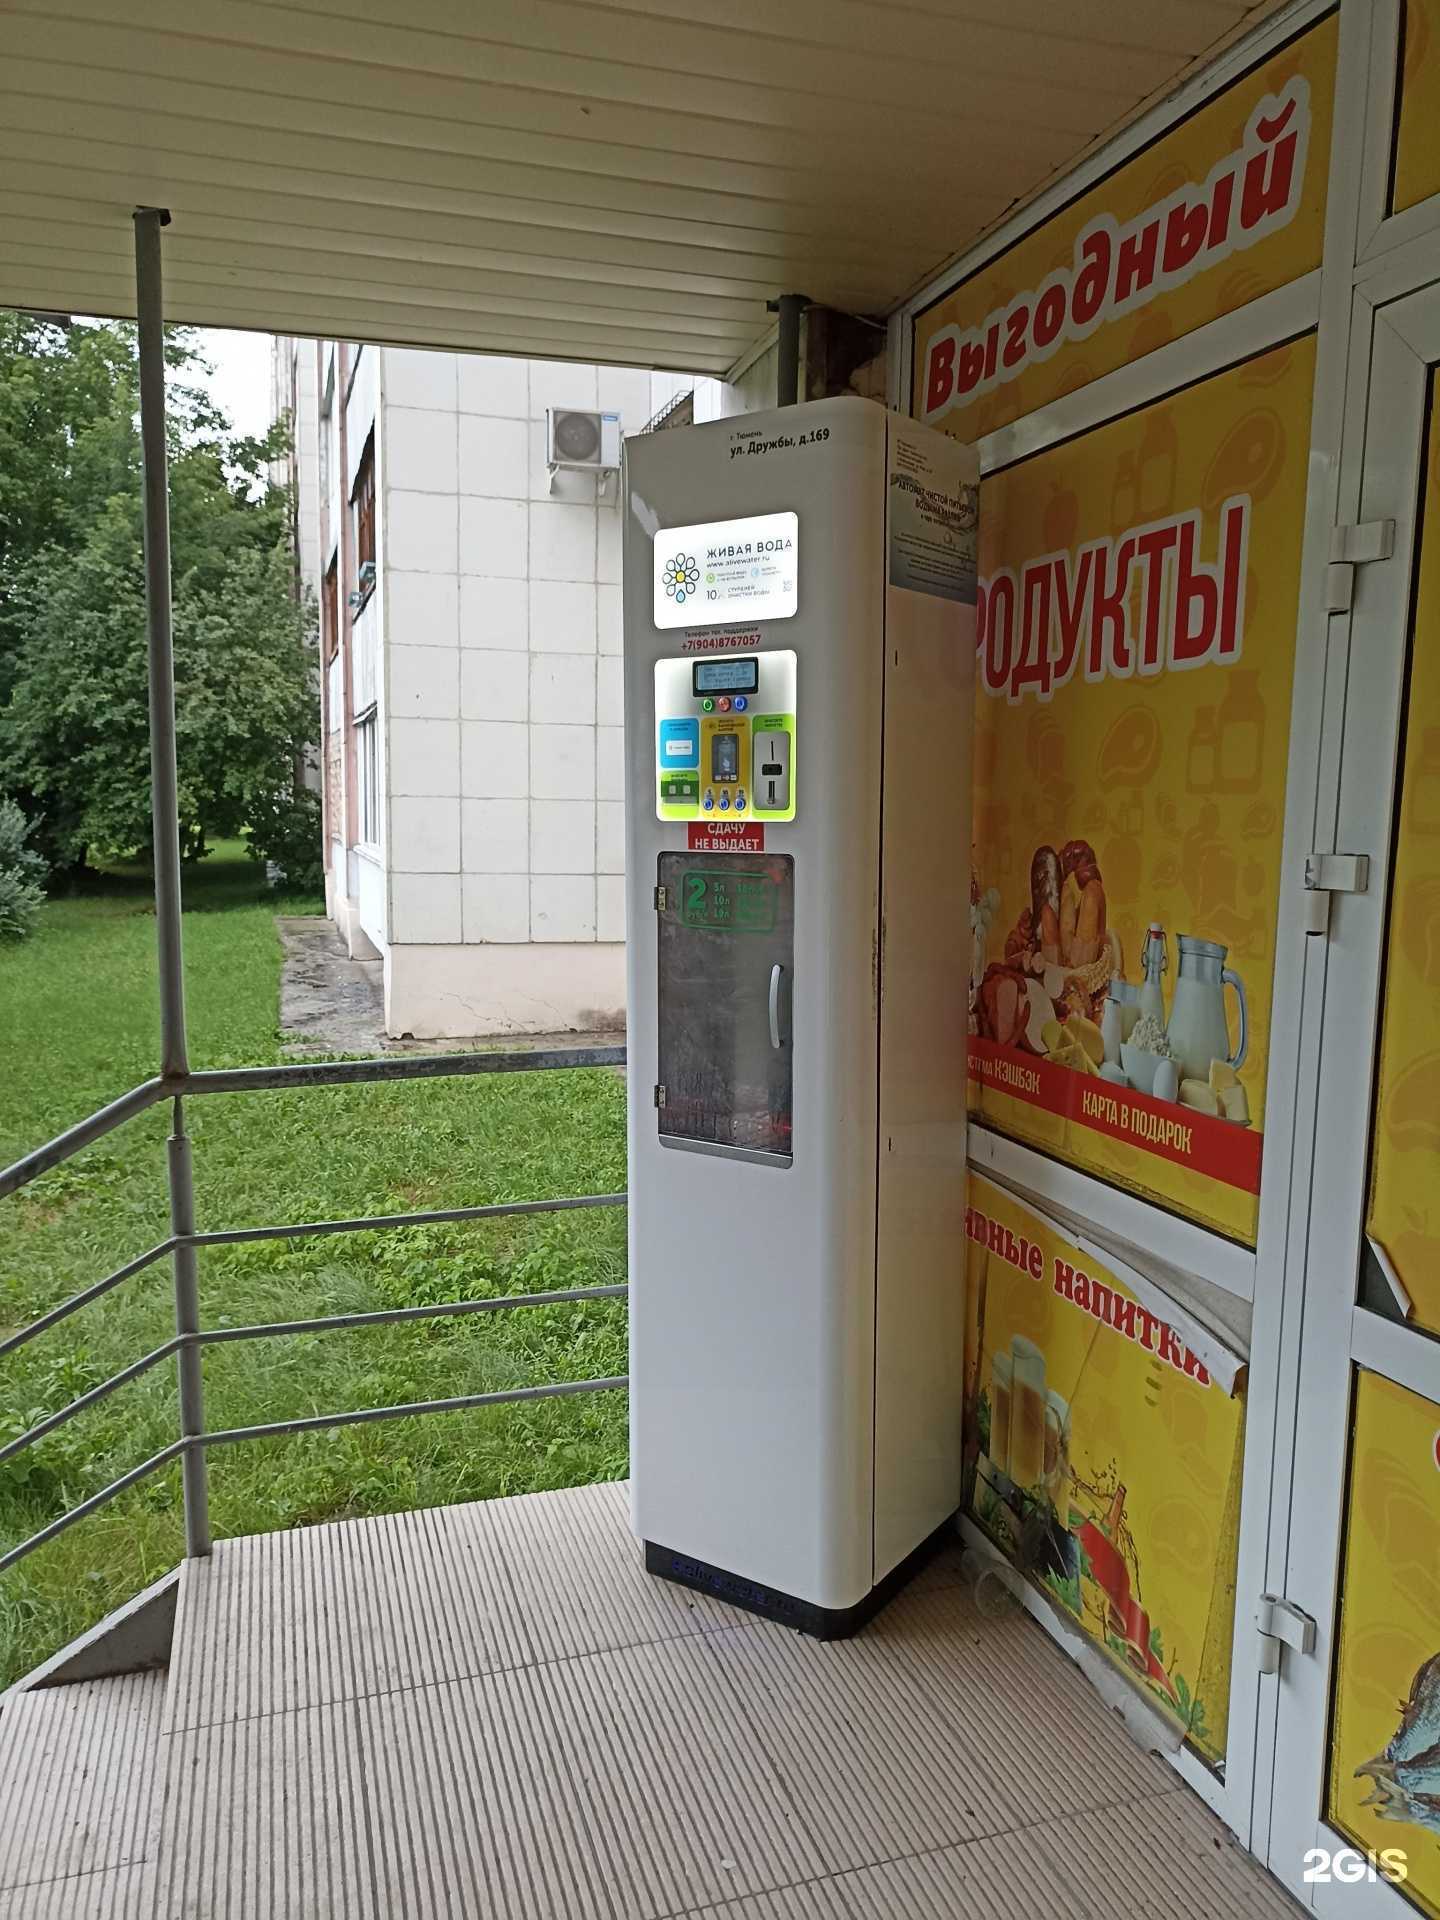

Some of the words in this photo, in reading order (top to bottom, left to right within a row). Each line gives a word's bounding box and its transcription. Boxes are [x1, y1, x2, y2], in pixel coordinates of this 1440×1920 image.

[926, 97, 1298, 414] Выгодный
[730, 445, 746, 459] ул.
[747, 436, 796, 455] Дружбы,
[798, 428, 830, 446] д.169
[706, 543, 752, 559] ЖИВАЯ
[757, 538, 793, 553] ВОДА
[681, 635, 762, 650] +7(904)8767057
[707, 822, 746, 834] СДАЧУ
[694, 838, 710, 850] НЕ
[712, 838, 760, 851] ВЫДАЕТ
[688, 878, 706, 909] 2
[994, 1058, 1041, 1095] КЭШБЭК
[1083, 1090, 1118, 1125] КАРТА
[1121, 1108, 1128, 1128] В
[1131, 1107, 1192, 1154] ПОДАРОК
